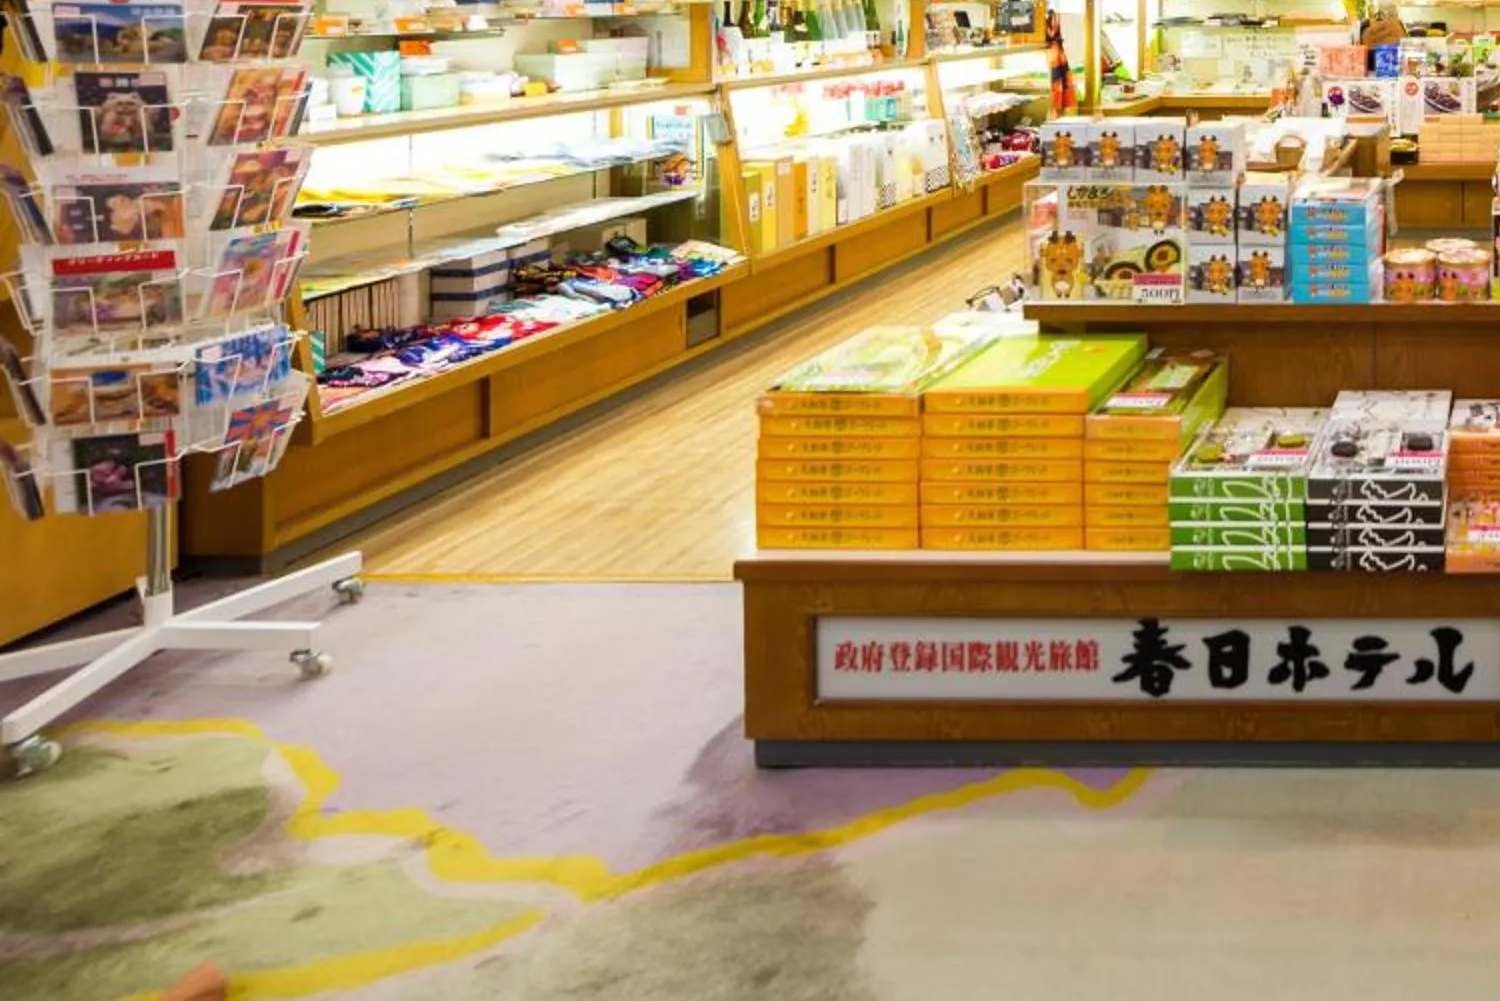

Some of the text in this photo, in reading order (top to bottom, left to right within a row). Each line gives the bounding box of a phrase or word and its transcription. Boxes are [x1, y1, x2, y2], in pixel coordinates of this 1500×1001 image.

[834, 618, 1475, 697] 政府登録国際観光旅館 春日ホテル
